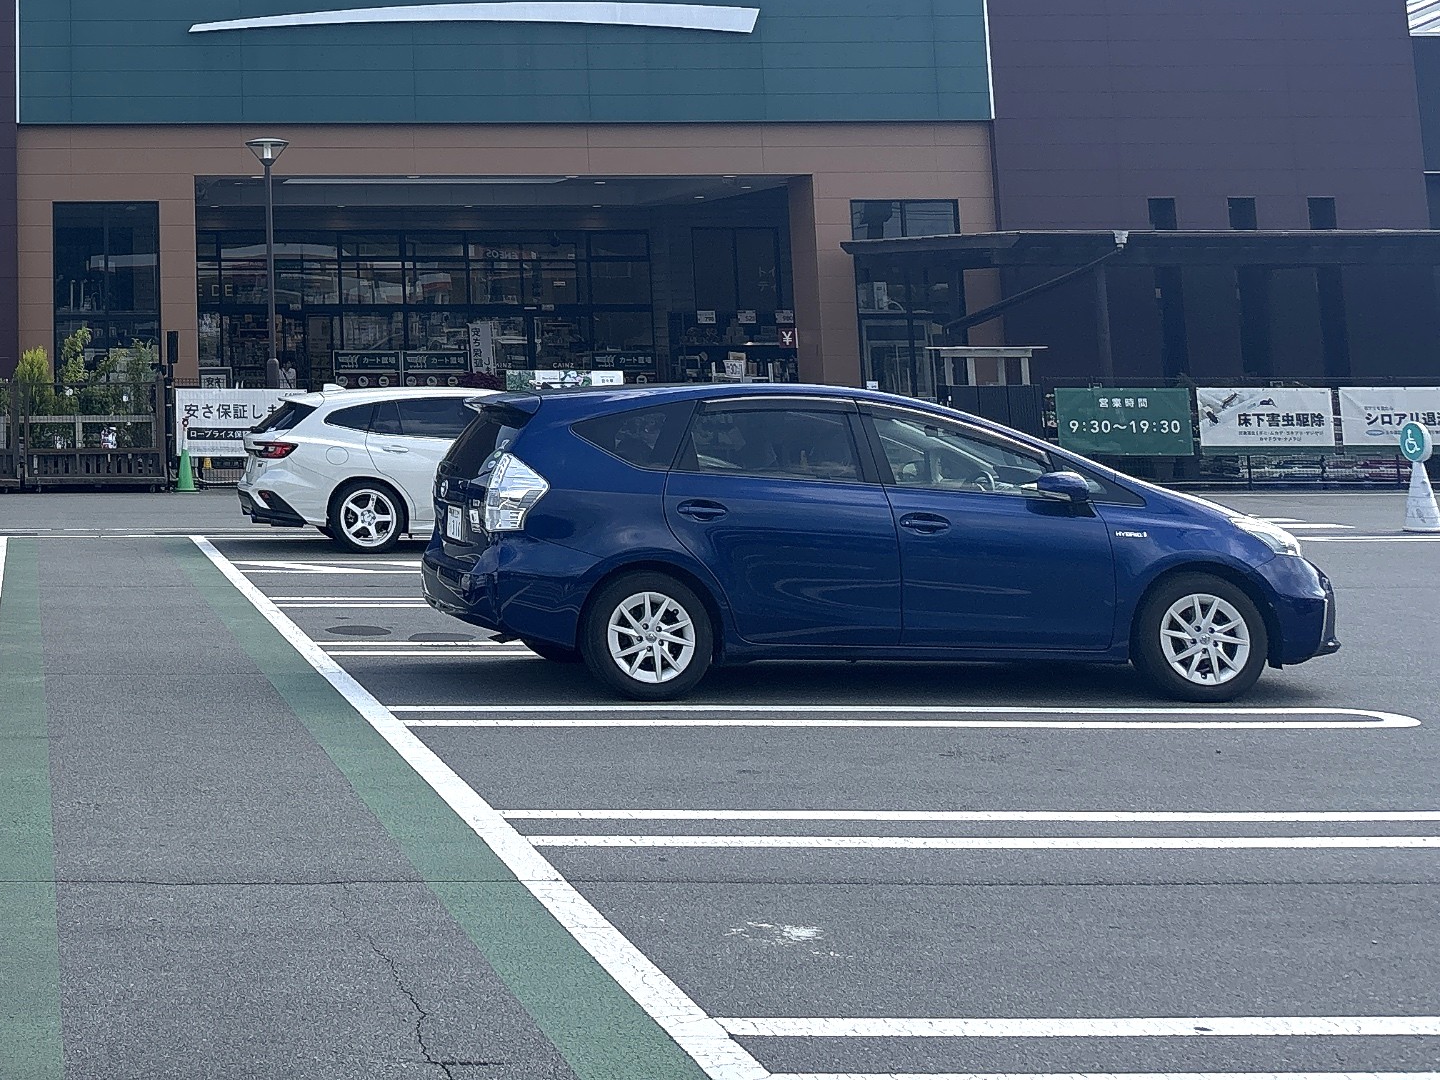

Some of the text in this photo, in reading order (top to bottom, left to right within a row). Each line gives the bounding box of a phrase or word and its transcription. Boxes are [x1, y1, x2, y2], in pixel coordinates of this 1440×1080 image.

[1098, 398, 1148, 408] 営業時間
[1237, 412, 1326, 428] 床下害虫駆除
